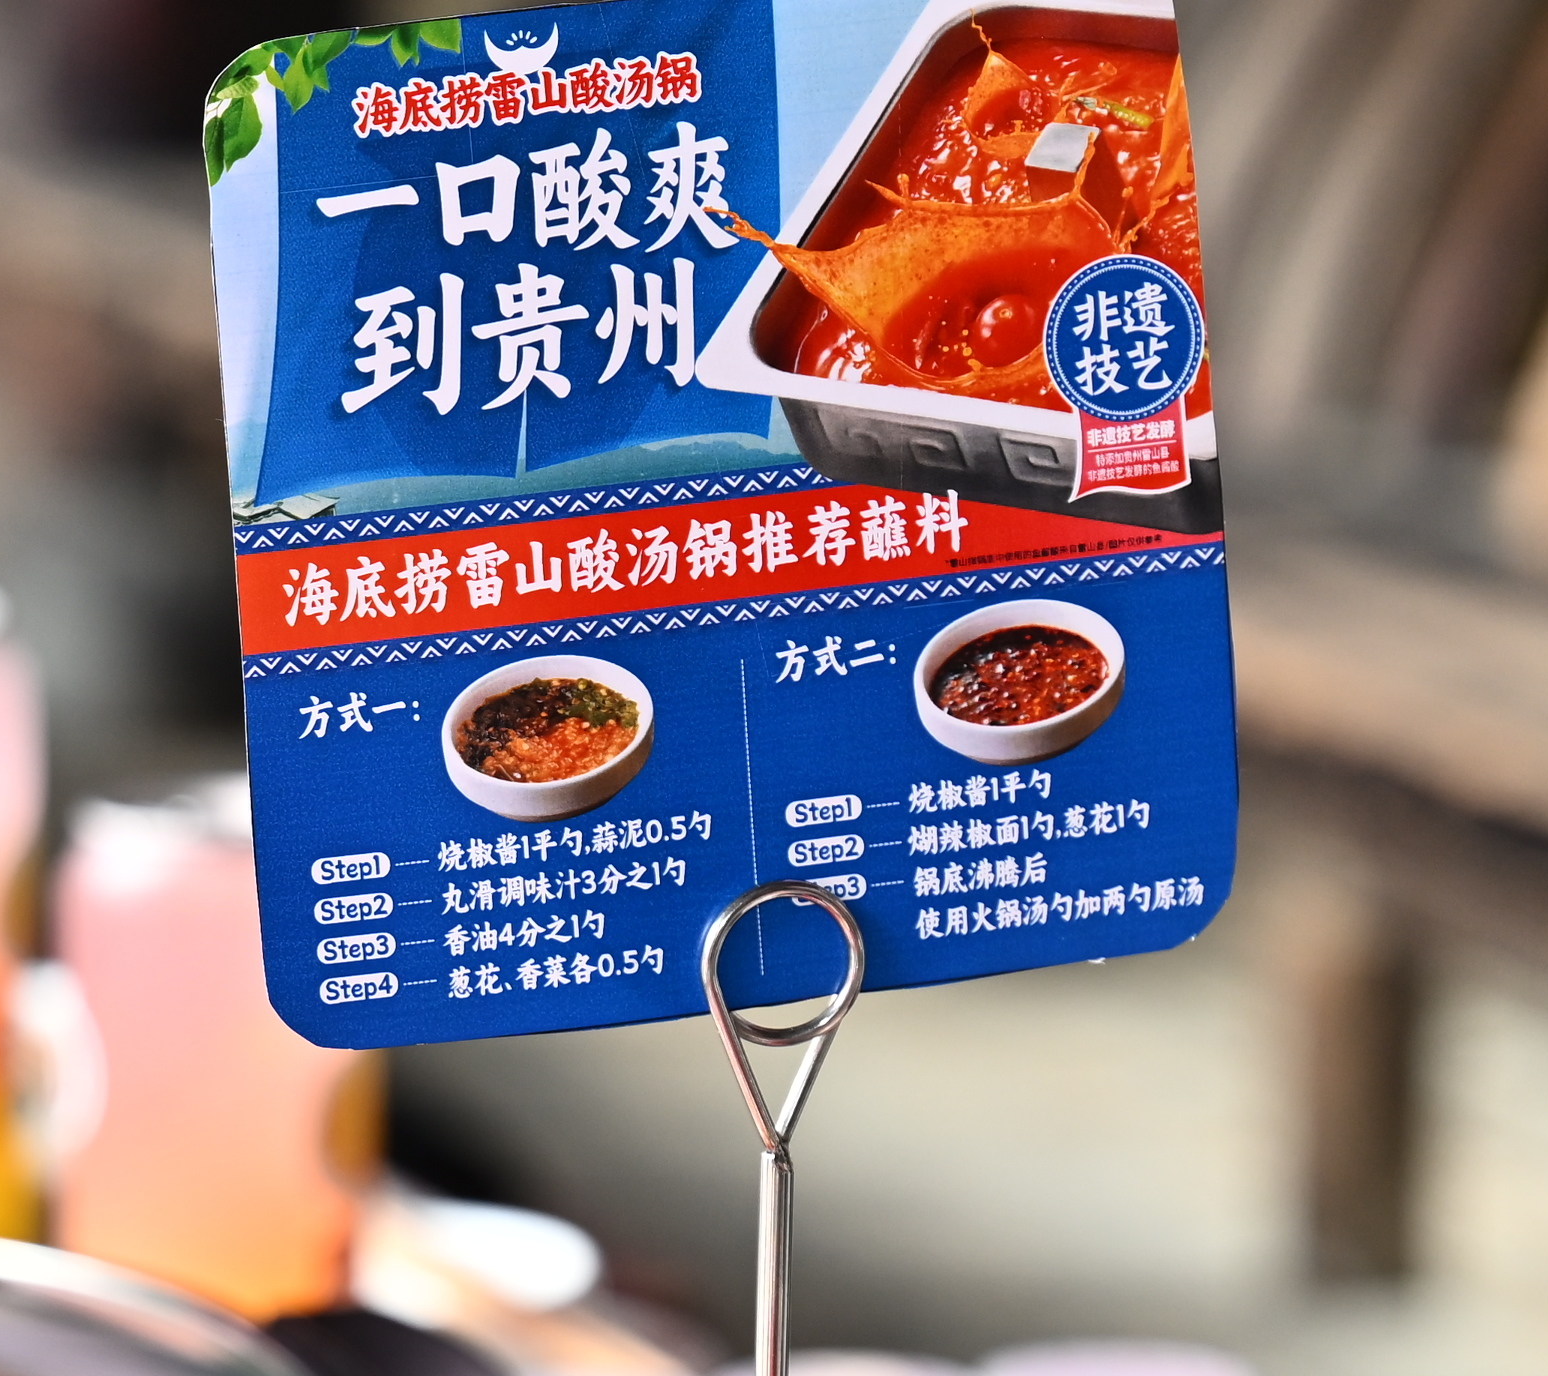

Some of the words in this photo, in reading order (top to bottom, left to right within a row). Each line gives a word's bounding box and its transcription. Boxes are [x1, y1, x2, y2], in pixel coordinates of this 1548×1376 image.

[354, 53, 700, 136] 海底捞雷山酸汤锅
[316, 122, 739, 253] 一口酸爽
[341, 257, 695, 415] 到贵州
[1072, 281, 1175, 341] 非遗
[1074, 338, 1173, 396] 技艺
[1087, 420, 1176, 447] 非遗技艺发酵
[282, 489, 968, 626] 海底捞雷山酸汤锅推荐蘸料
[794, 797, 853, 824] Step1
[908, 769, 1052, 814] 烧椒酱1平勺
[320, 853, 381, 882] Step1
[794, 837, 859, 865] Step2
[913, 853, 1049, 897] 锅底沸腾后
[320, 894, 387, 923] Step2
[441, 856, 687, 916] 丸滑调味汁3分之1勺
[915, 875, 1205, 941] 使用火锅汤勺加两勺原汤
[323, 934, 390, 962] Step3
[443, 910, 606, 957] 香油4分之1勺
[325, 974, 393, 1002] Step4
[448, 945, 665, 1000] 葱花、香菜各0.5勺
